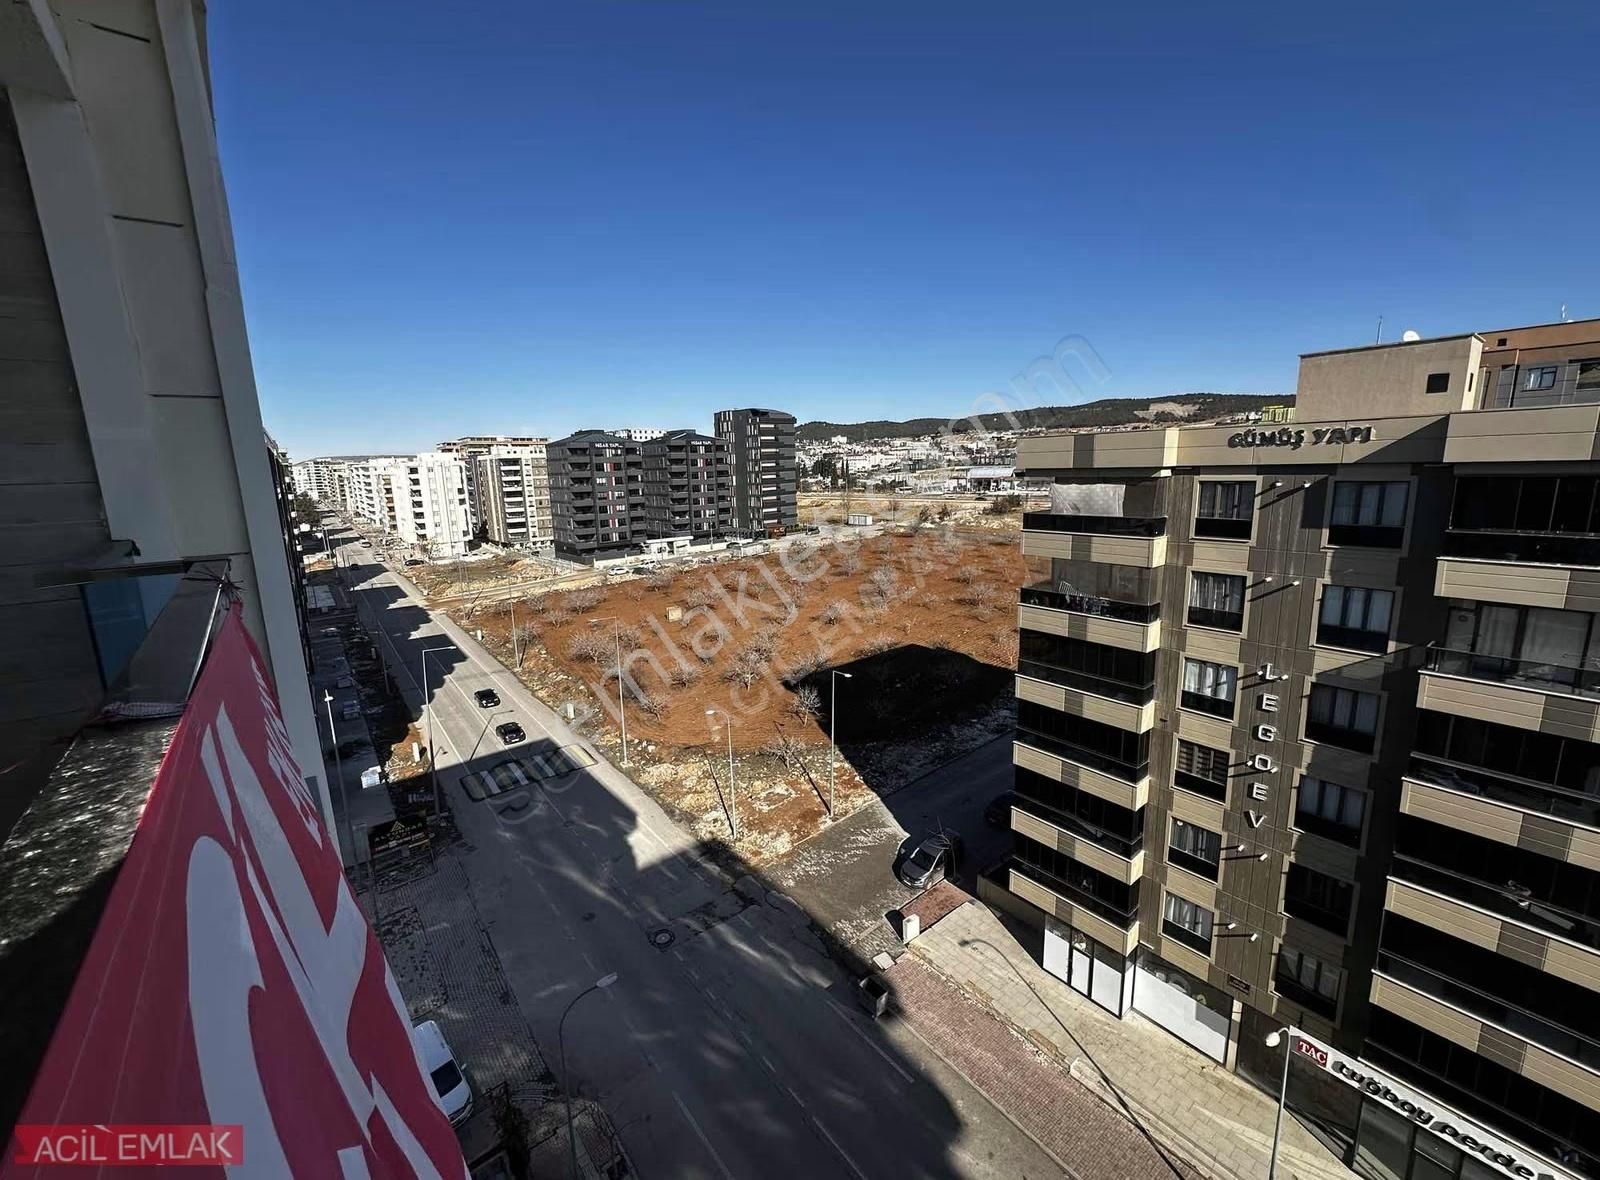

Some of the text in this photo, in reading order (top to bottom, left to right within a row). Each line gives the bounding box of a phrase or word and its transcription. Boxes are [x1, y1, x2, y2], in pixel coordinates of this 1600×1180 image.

[1227, 425, 1376, 450] GÜMÜŞ YAPI
[1249, 663, 1279, 829] LEGOEV
